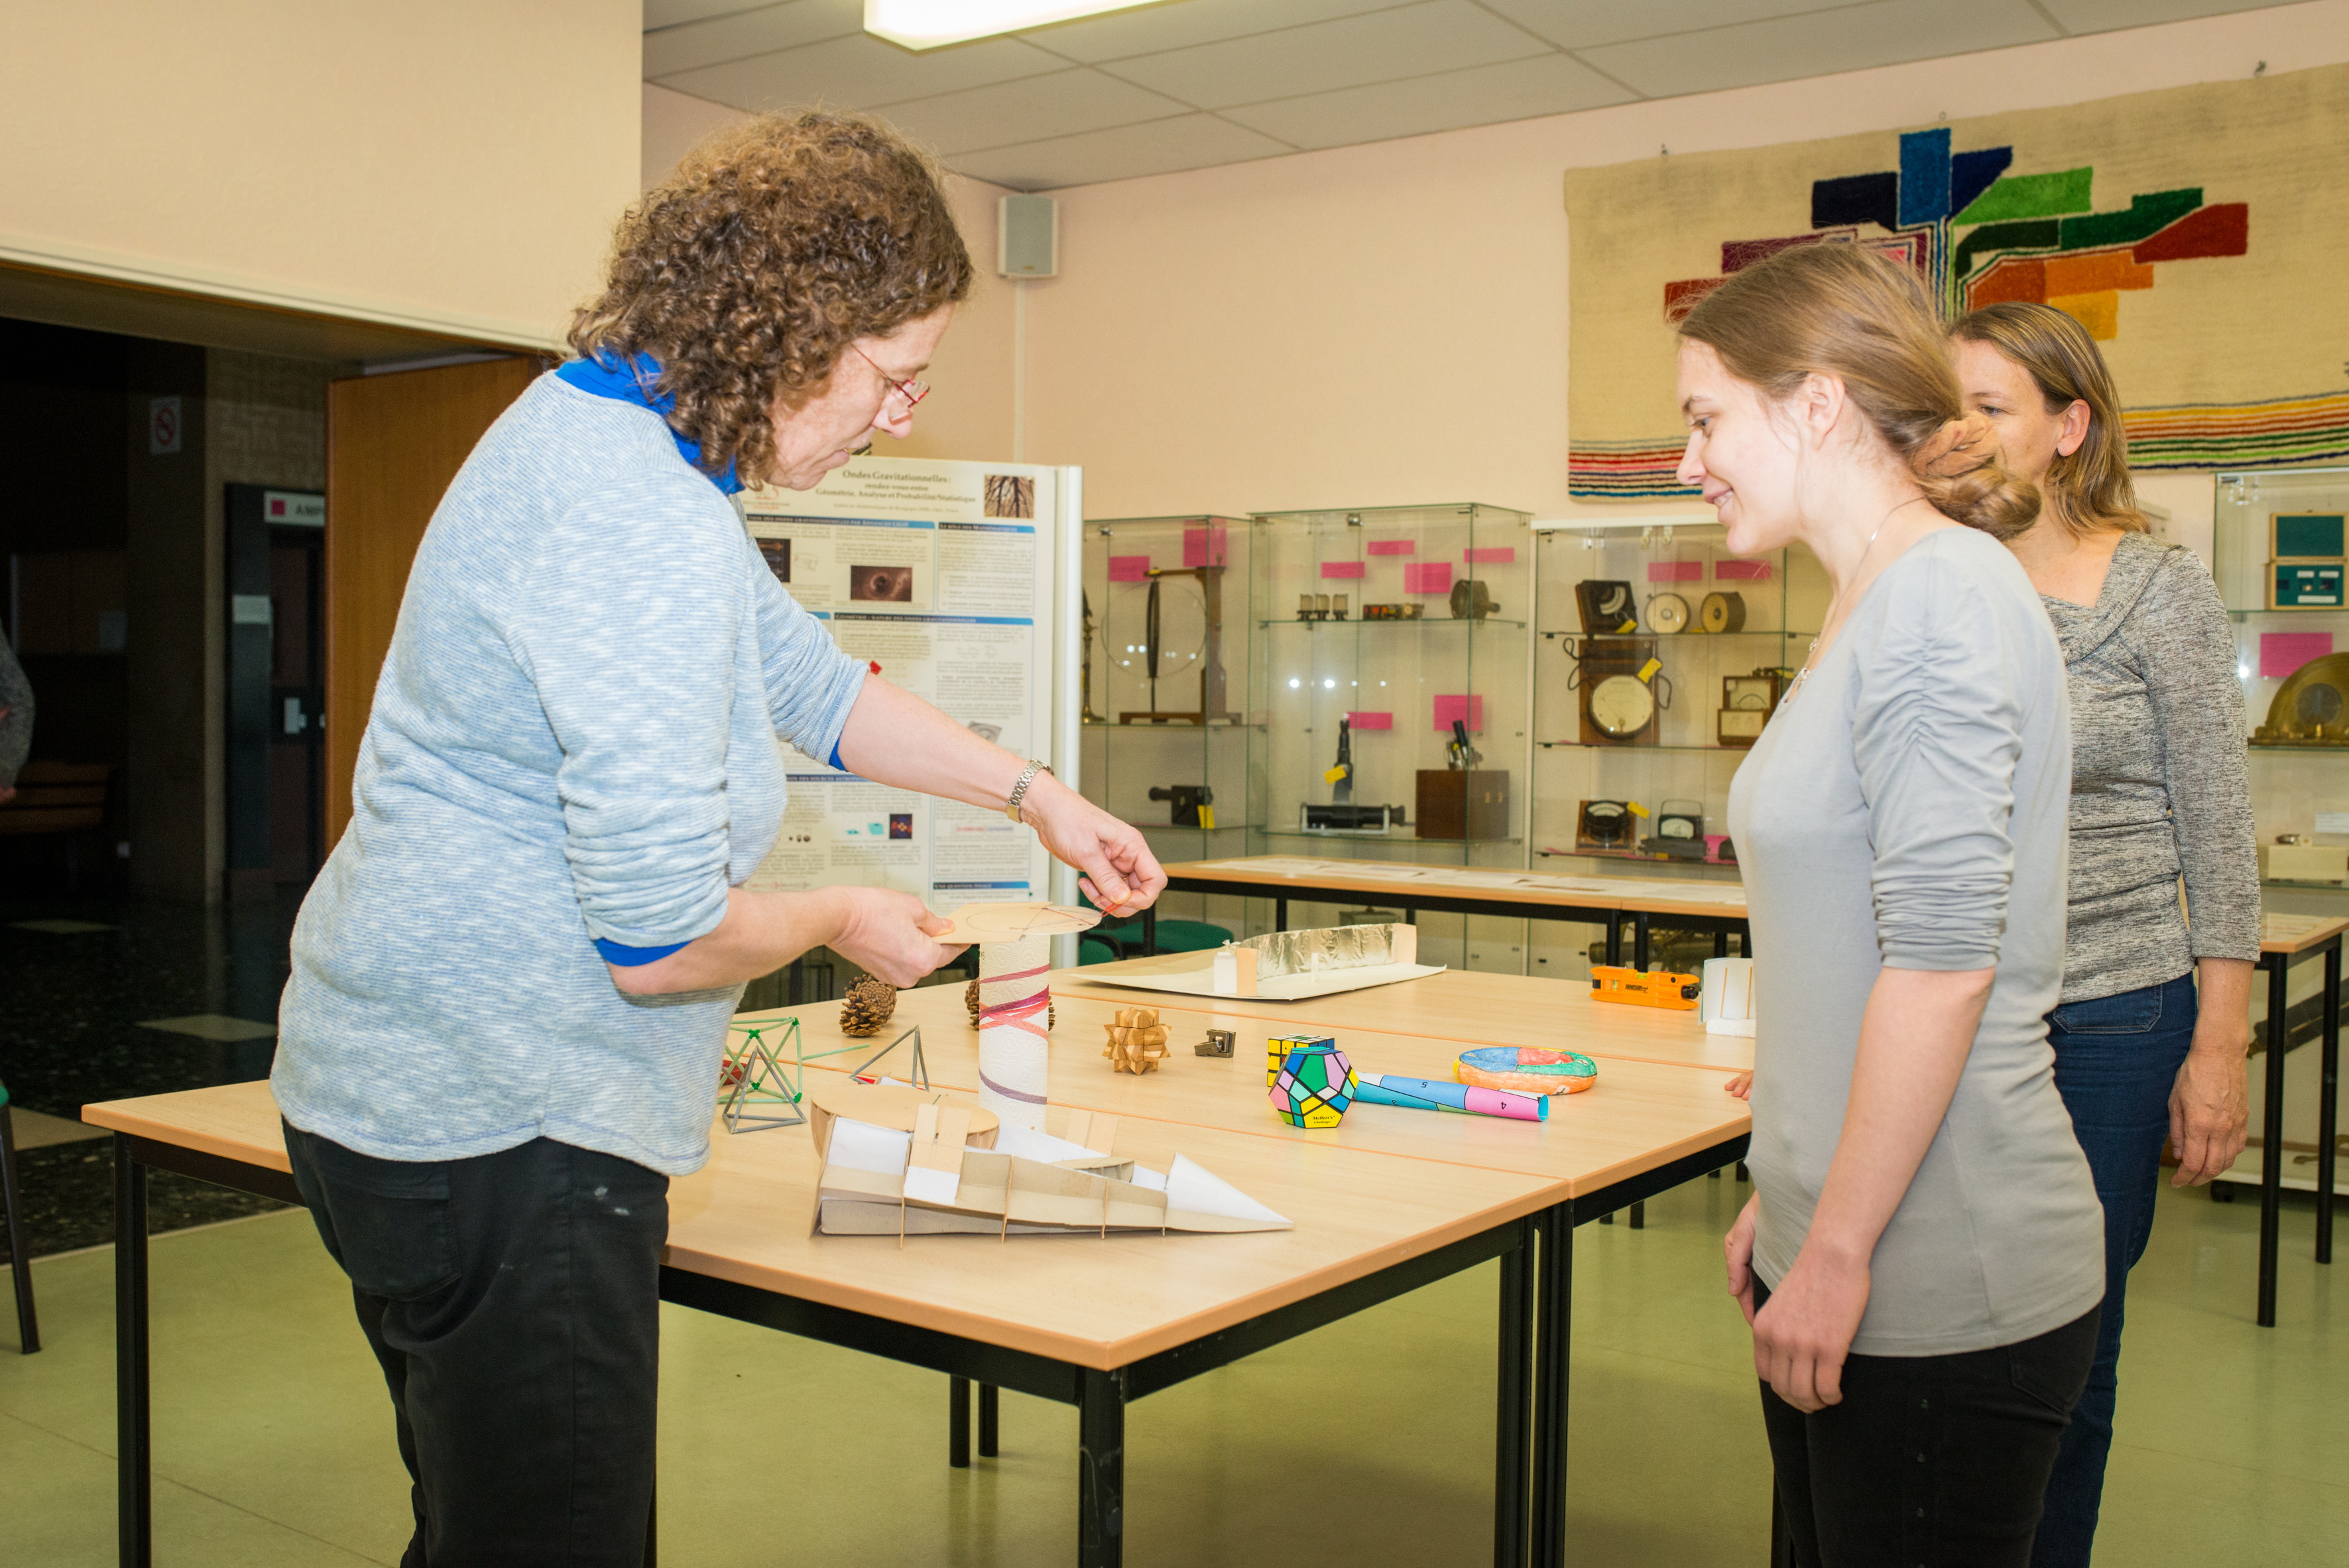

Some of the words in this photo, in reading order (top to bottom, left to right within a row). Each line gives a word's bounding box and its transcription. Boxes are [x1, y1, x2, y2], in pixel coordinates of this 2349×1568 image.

[843, 469, 871, 479] Ondes
[873, 471, 947, 483] Gravitationnelles
[859, 490, 886, 500] Analyse
[1500, 1101, 1508, 1110] 4
